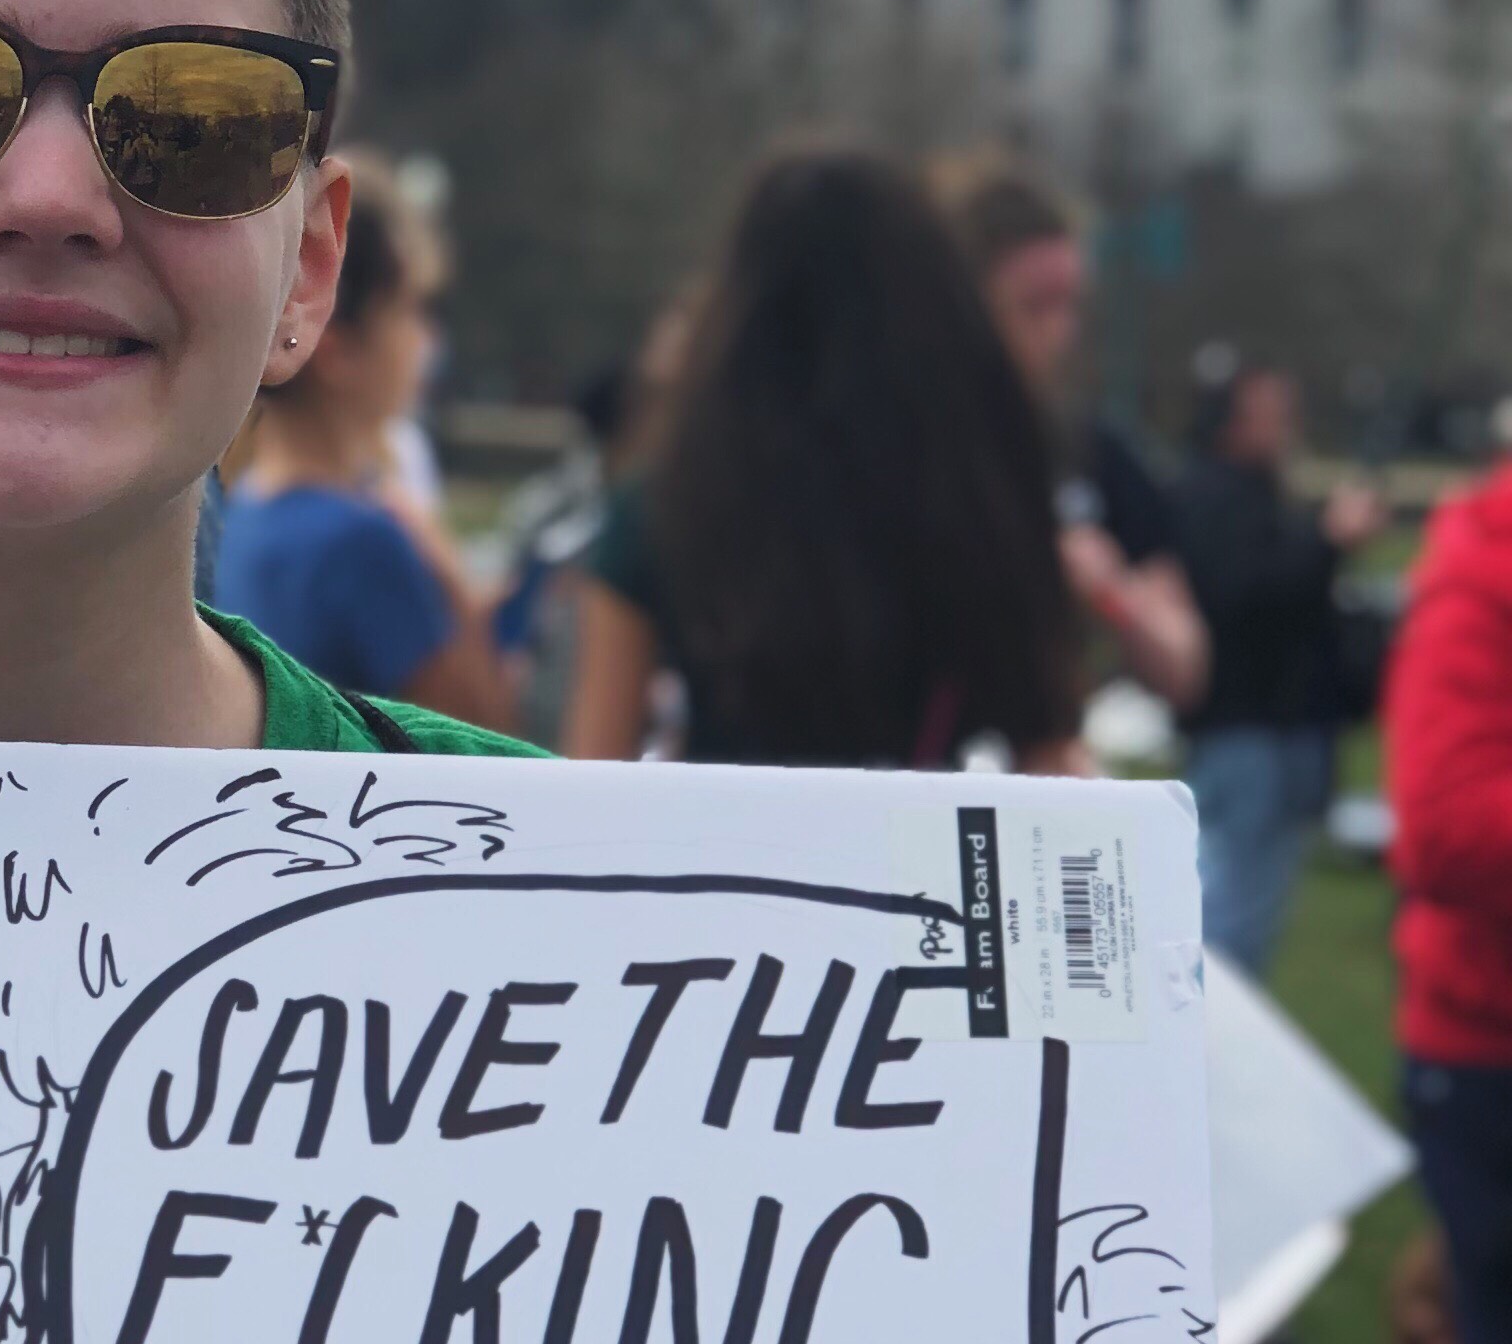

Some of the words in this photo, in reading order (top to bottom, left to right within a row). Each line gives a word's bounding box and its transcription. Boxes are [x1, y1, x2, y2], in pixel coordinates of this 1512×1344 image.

[967, 833, 991, 919] Board
[1092, 875, 1106, 916] 05557
[1007, 898, 1021, 944] white
[1097, 927, 1110, 969] 45173
[976, 931, 996, 1010] Fam
[149, 978, 578, 1158] SAVE
[600, 954, 969, 1134] THE
